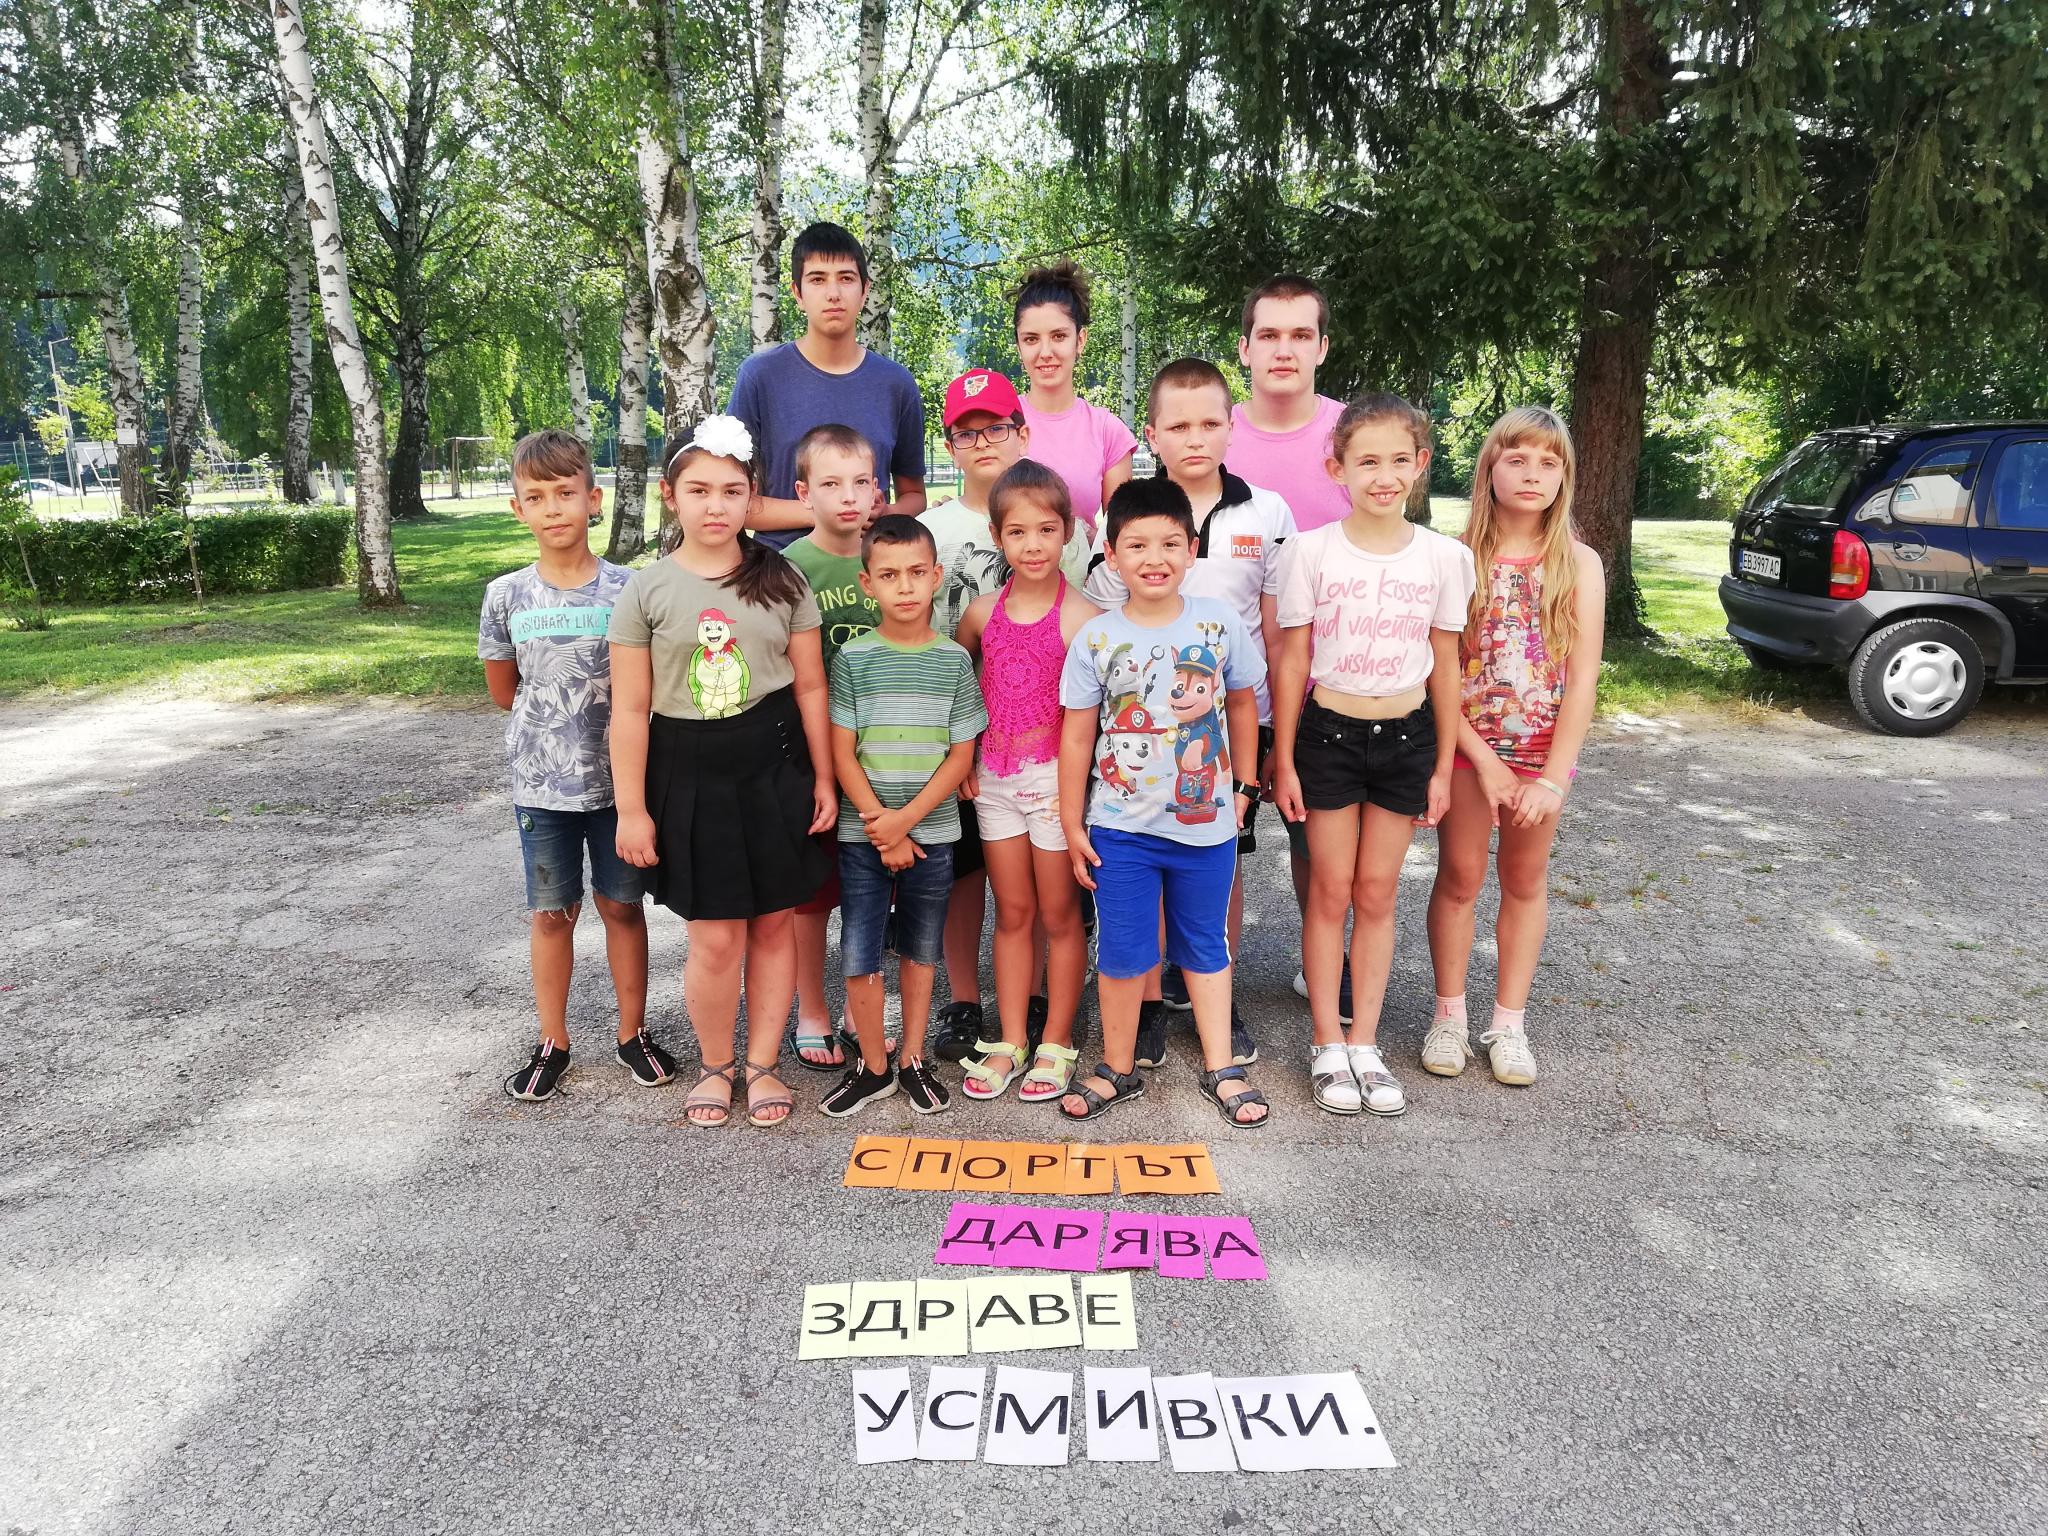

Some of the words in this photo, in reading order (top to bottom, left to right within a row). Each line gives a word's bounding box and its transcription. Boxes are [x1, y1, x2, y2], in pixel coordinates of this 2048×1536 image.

[1753, 555, 1770, 574] 3997
[814, 584, 857, 611] ING
[863, 597, 879, 611] OF
[1316, 572, 1368, 606] Love
[853, 1147, 1206, 1180] СПОРТЪТ
[942, 1217, 1260, 1260] ДАРЯВА
[808, 1293, 1122, 1342] ЗДРАВЕ
[859, 1388, 1377, 1441] УСМИВКИ.
